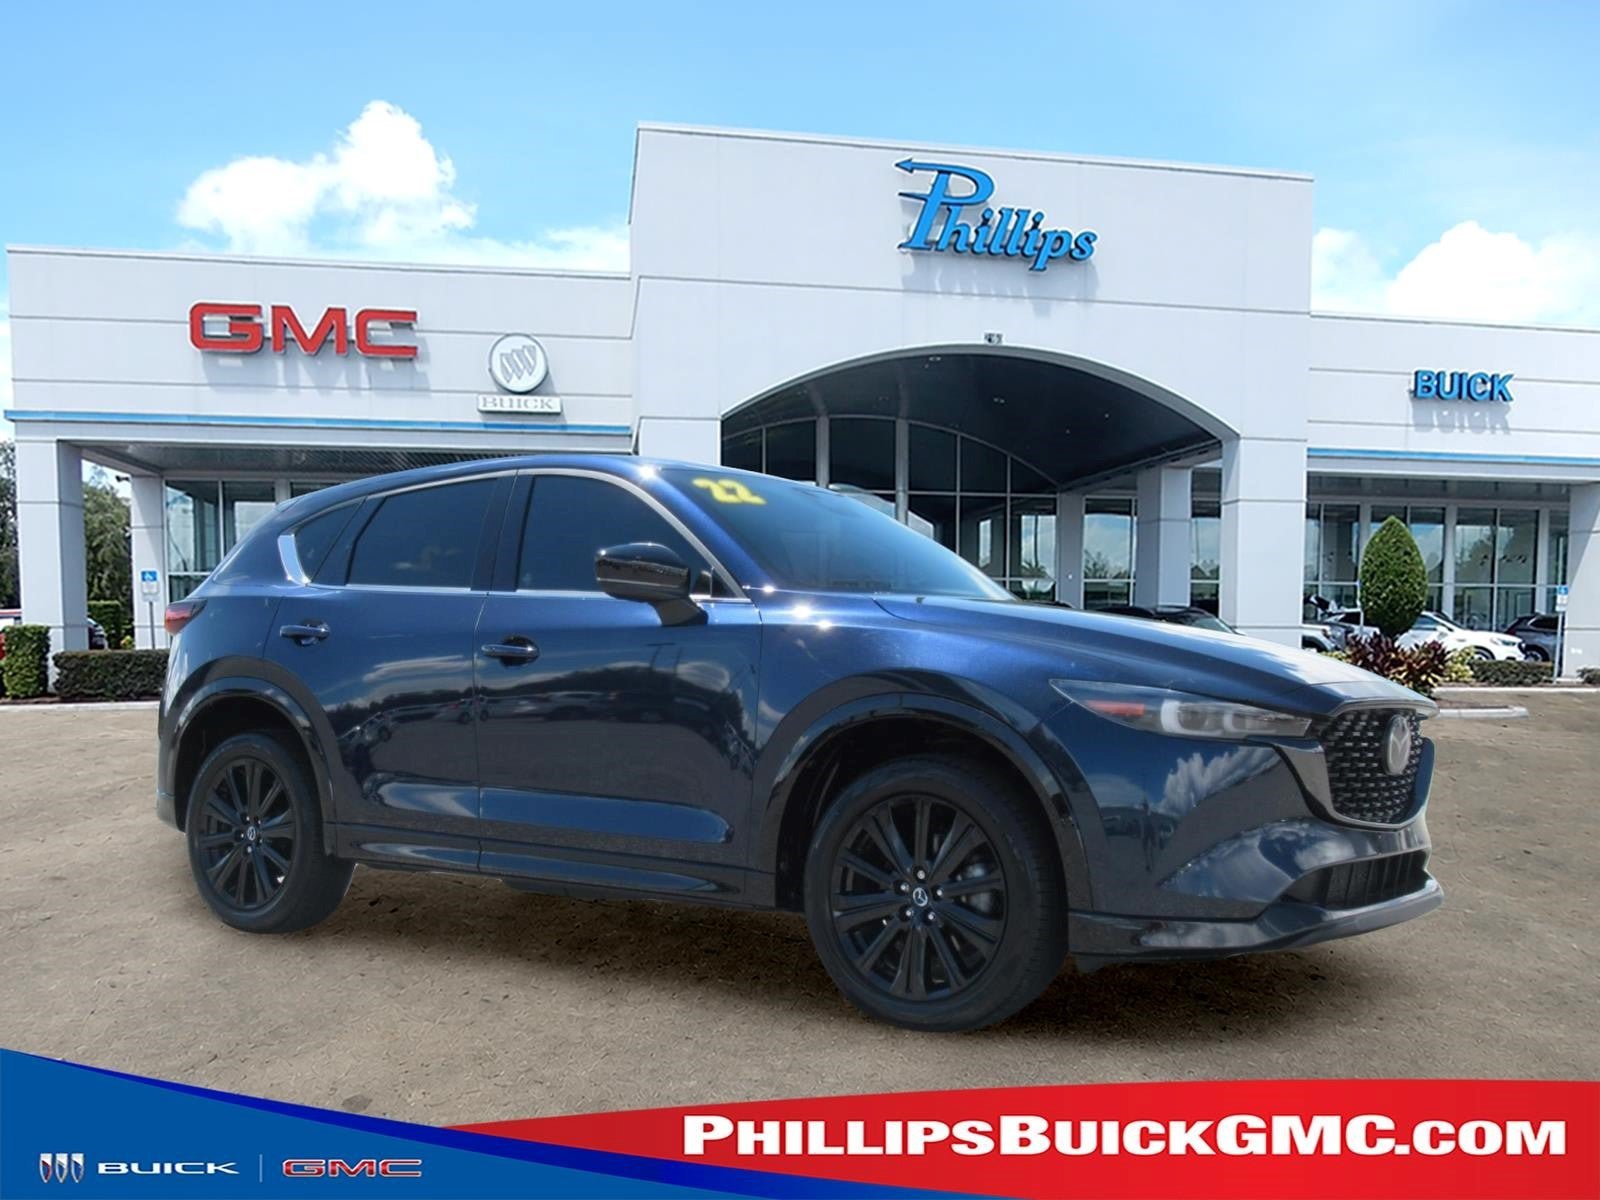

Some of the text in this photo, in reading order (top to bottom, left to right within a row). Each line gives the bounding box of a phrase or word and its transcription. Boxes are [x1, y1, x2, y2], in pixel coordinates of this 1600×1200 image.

[896, 157, 1098, 271] Phillips
[190, 303, 418, 359] GMC
[1412, 370, 1514, 403] BUICK
[482, 399, 554, 411] BUICK
[693, 478, 766, 504] 22
